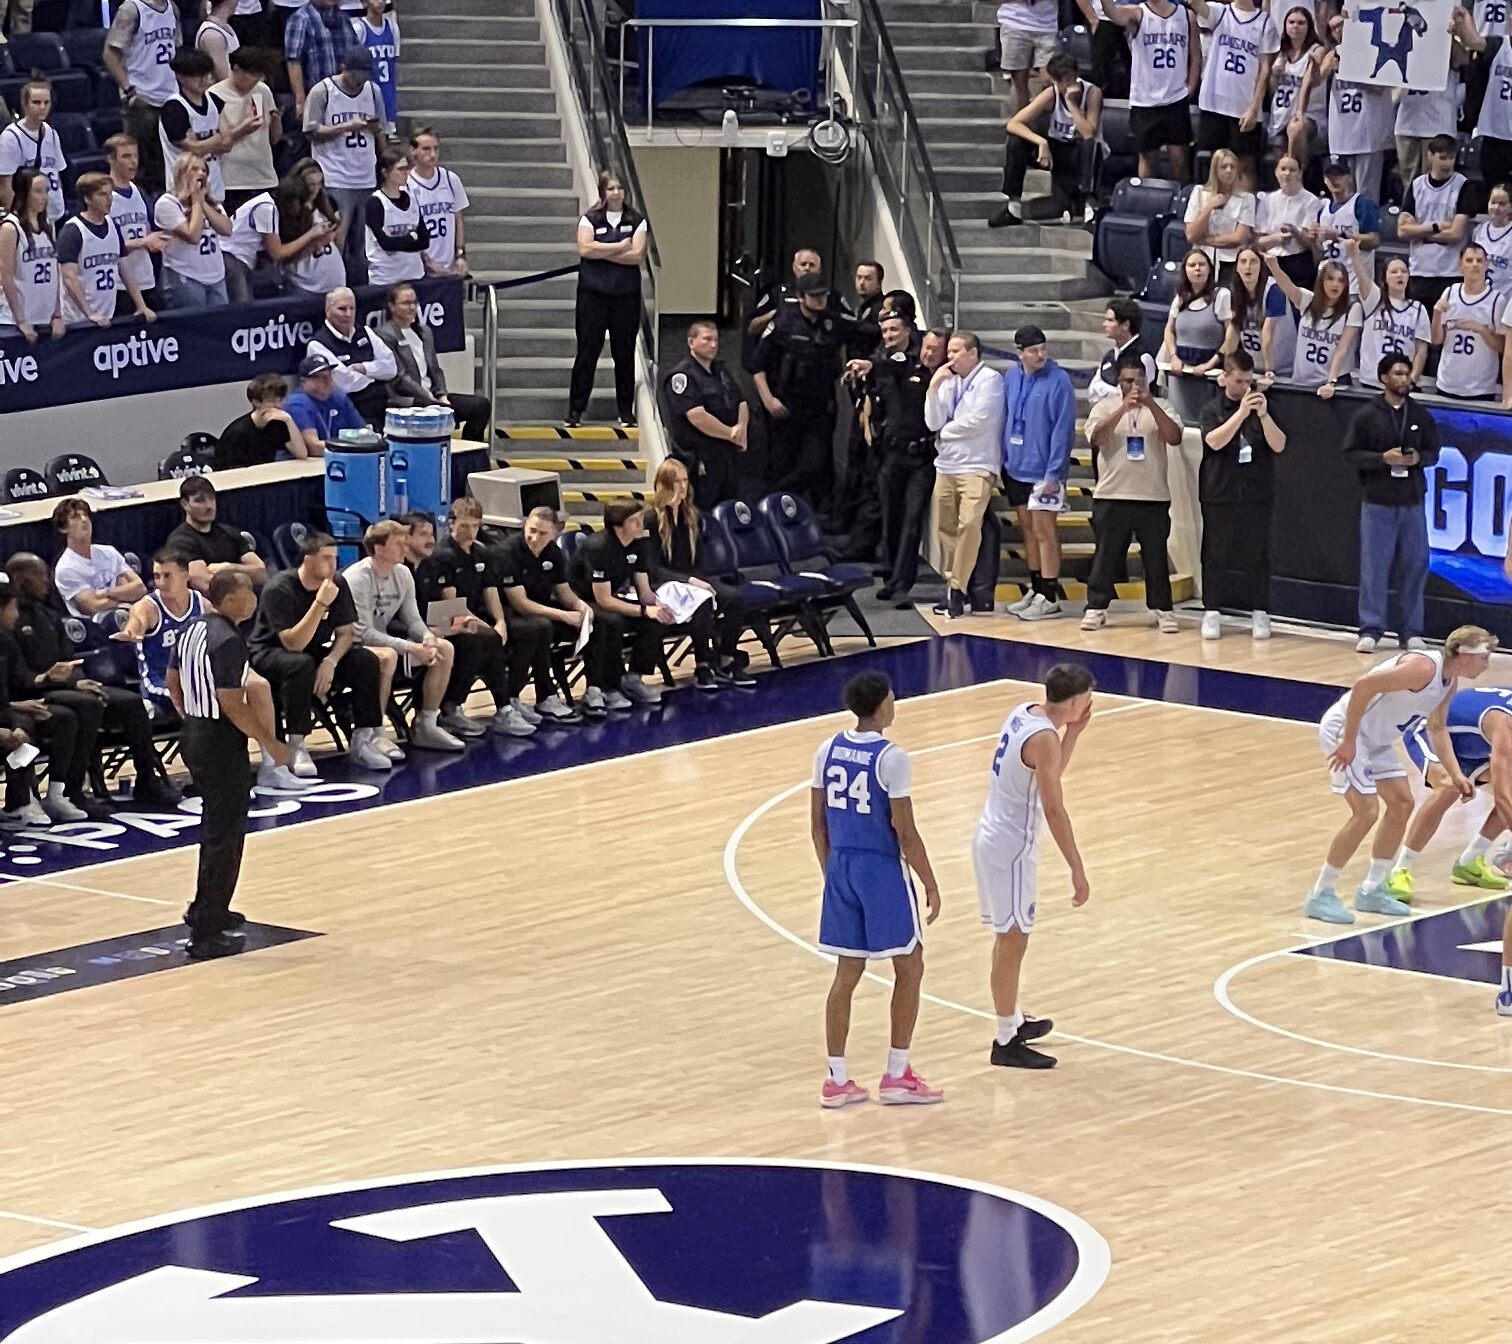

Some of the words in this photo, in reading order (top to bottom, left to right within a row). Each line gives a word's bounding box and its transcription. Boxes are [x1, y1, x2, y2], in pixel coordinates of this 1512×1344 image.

[1485, 4, 1505, 23] 26
[1152, 48, 1177, 68] 26
[1223, 52, 1246, 74] 26
[378, 62, 390, 82] 3
[1341, 93, 1362, 113] 26
[426, 218, 447, 239] 26
[34, 262, 51, 284] 26
[96, 268, 114, 290] 26
[231, 315, 313, 361] aptive
[1452, 333, 1474, 356] 26
[93, 329, 179, 376] aptive
[1306, 342, 1329, 365] 26
[826, 764, 872, 814] 24
